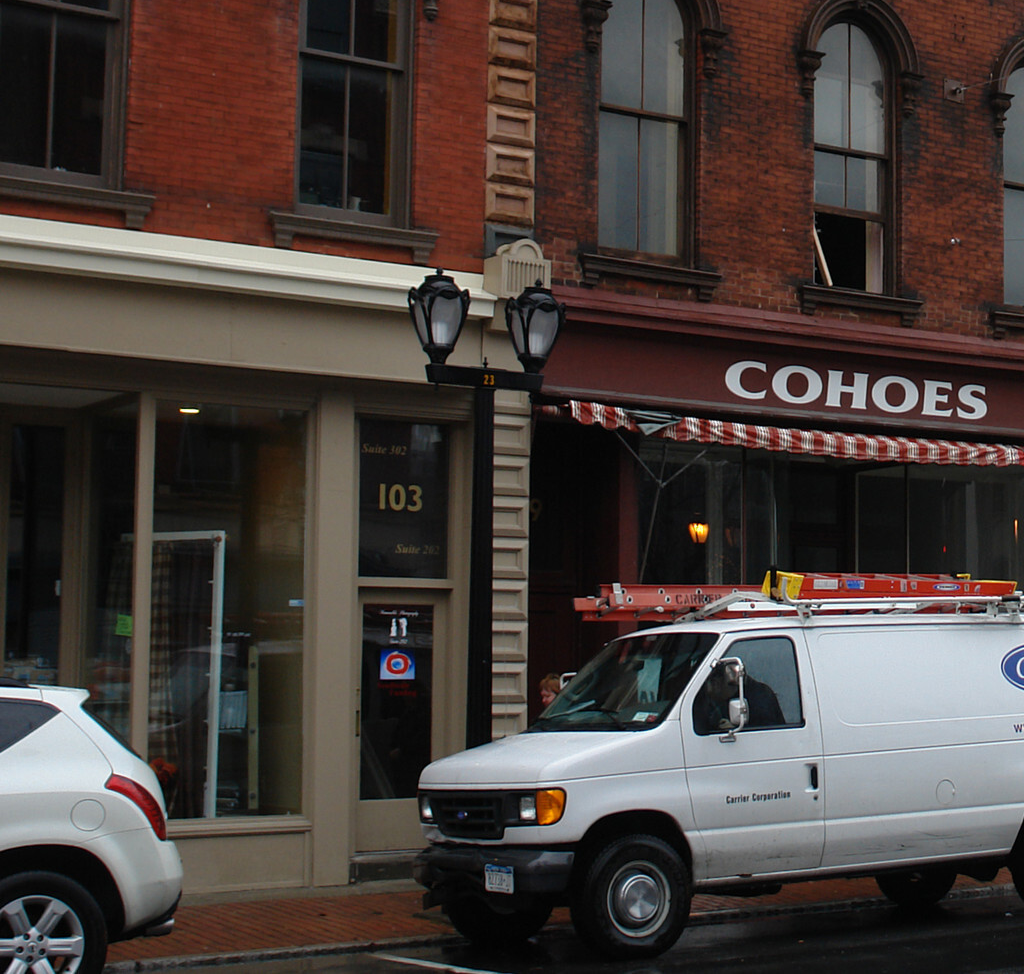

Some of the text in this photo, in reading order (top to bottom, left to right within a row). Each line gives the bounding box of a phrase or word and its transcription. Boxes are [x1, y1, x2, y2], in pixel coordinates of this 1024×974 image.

[483, 374, 495, 386] 23
[725, 360, 988, 419] COHOES
[361, 442, 407, 456] Suite 302
[379, 483, 423, 512] 103
[395, 543, 421, 555] Suite
[675, 593, 722, 605] CARRER
[726, 790, 791, 804] Carrier Corporation
